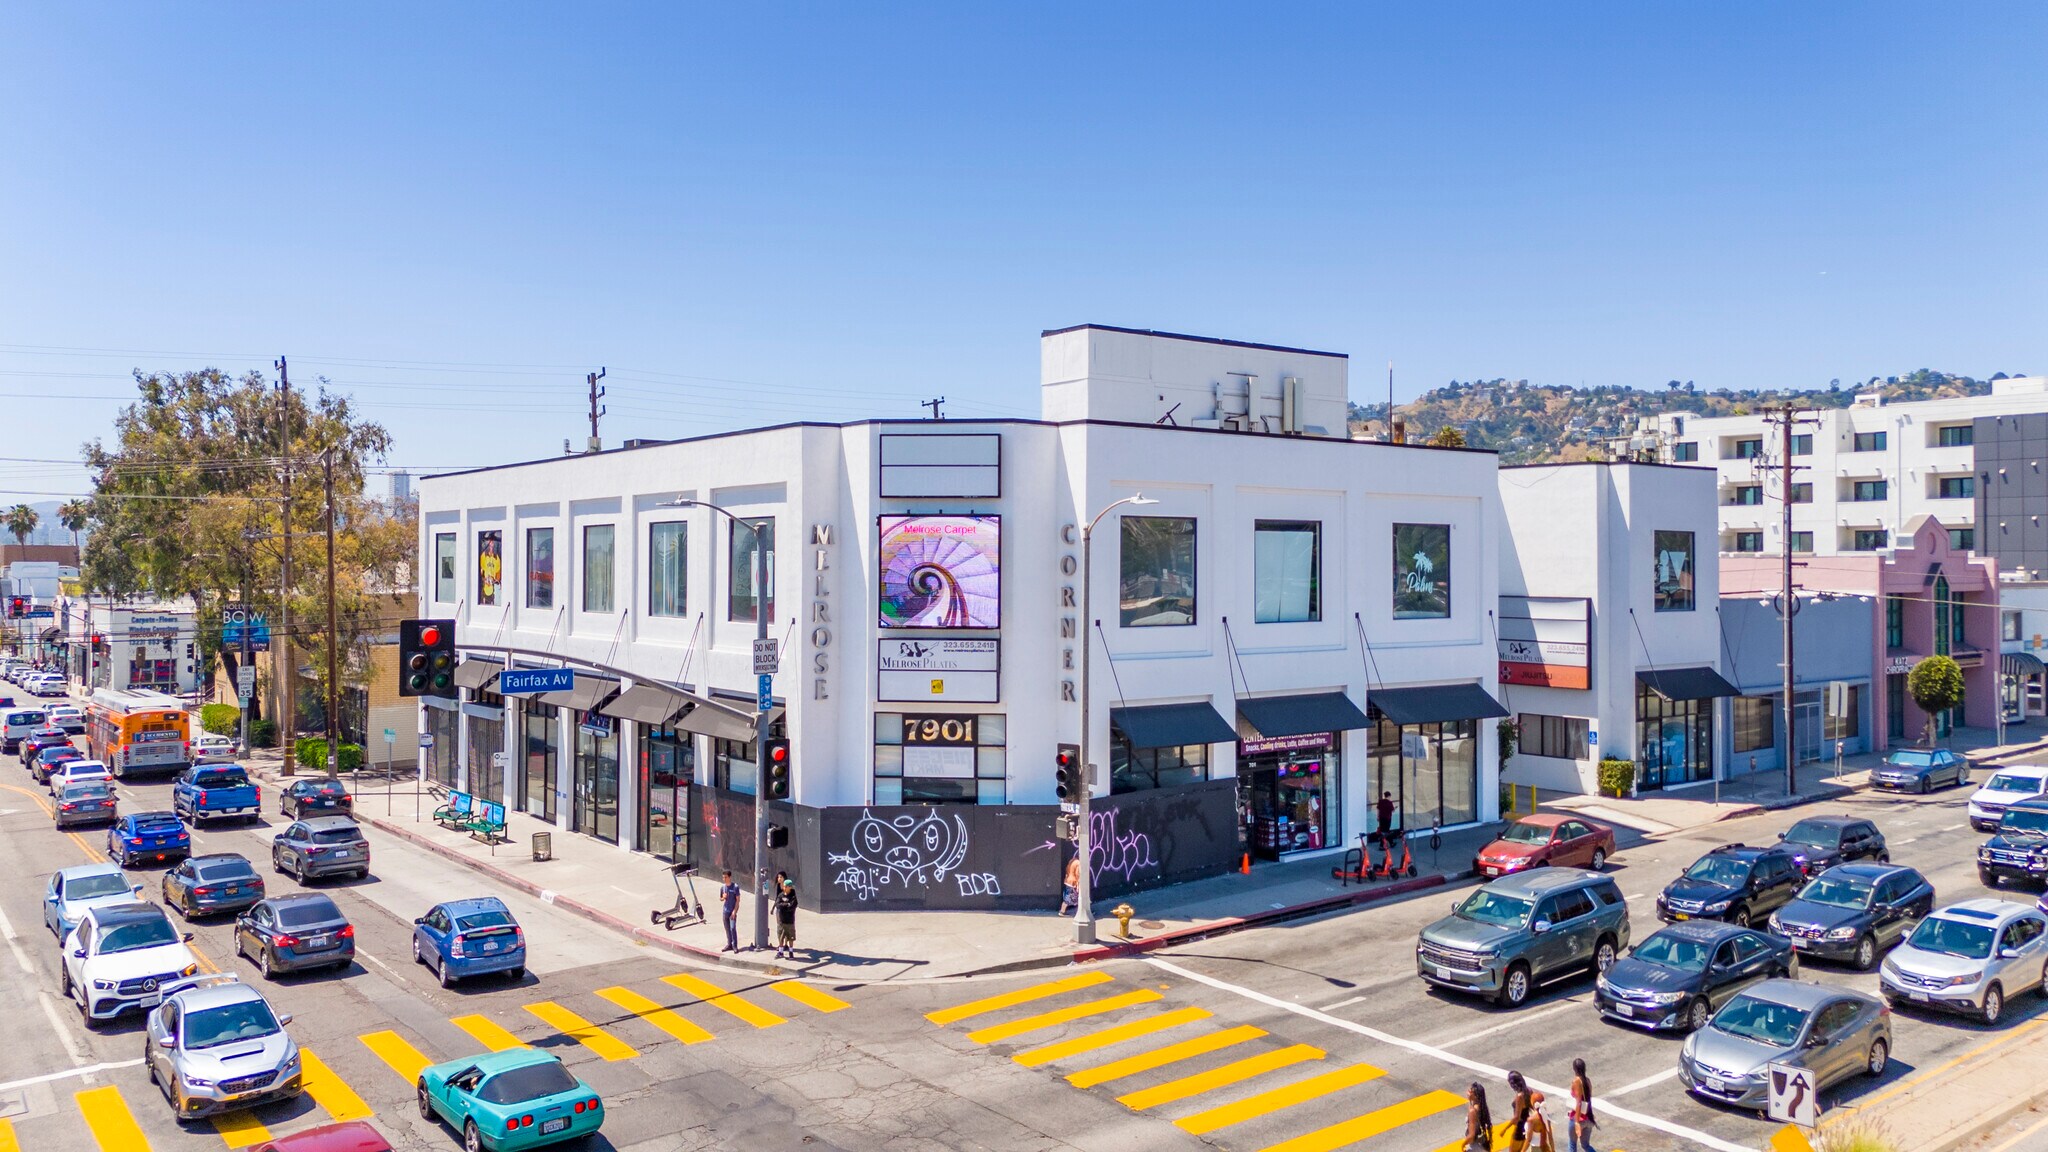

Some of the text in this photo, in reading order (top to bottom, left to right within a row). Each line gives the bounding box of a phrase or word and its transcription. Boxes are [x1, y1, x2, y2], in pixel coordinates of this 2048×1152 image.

[904, 525, 977, 536] Melrose Carpet
[811, 524, 835, 700] MELROSE
[1060, 524, 1076, 702] CORNER
[755, 643, 776, 652] DO NOT
[943, 641, 995, 649] 323.655.2418
[755, 655, 776, 664] BLOCK
[882, 657, 958, 669] MELROSE PILATES
[506, 673, 568, 688] Fairfax Av
[905, 718, 973, 742] 7901
